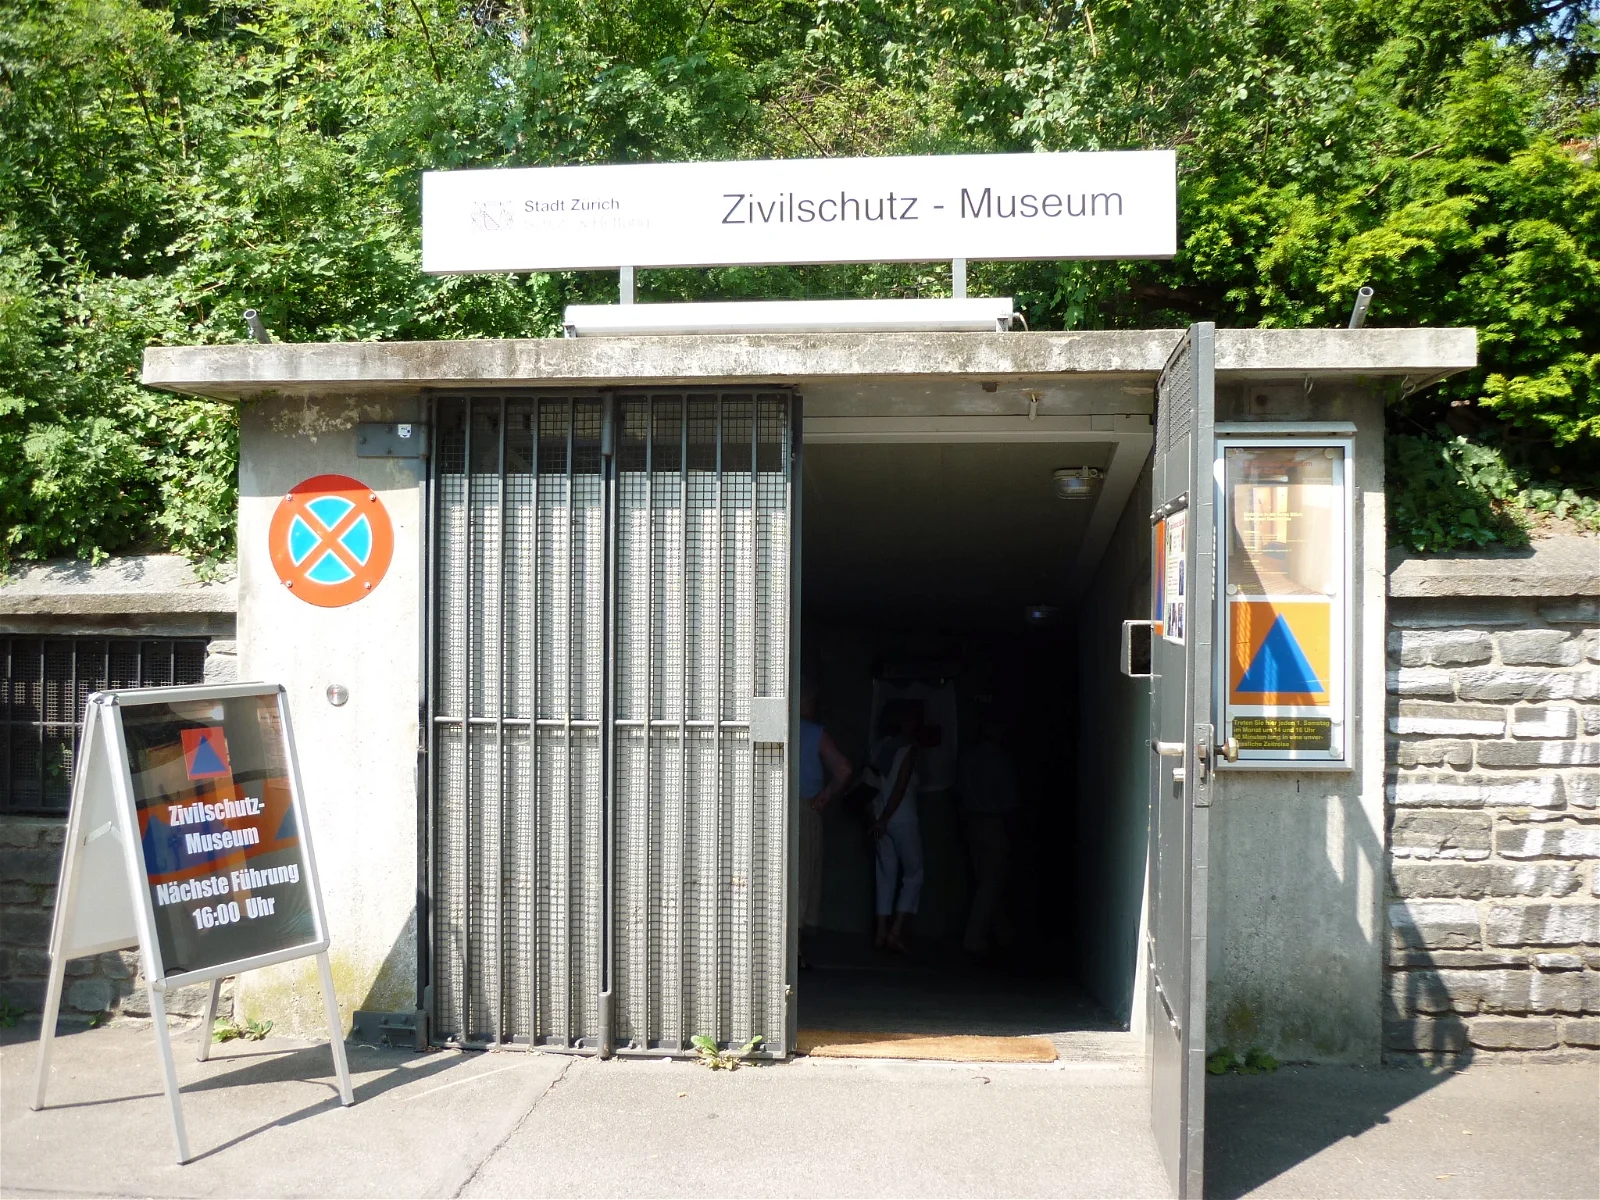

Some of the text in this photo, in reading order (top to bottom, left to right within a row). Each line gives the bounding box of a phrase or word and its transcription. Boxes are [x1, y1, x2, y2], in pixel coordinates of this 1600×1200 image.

[524, 199, 565, 213] Stadt
[721, 190, 919, 225] Zivilschutz
[960, 187, 1123, 219] Museum
[168, 797, 265, 827] Zivilschutz-
[185, 826, 260, 854] Museum
[156, 863, 300, 906] Nächste Führung
[192, 896, 276, 930] 16:00 Uhr
